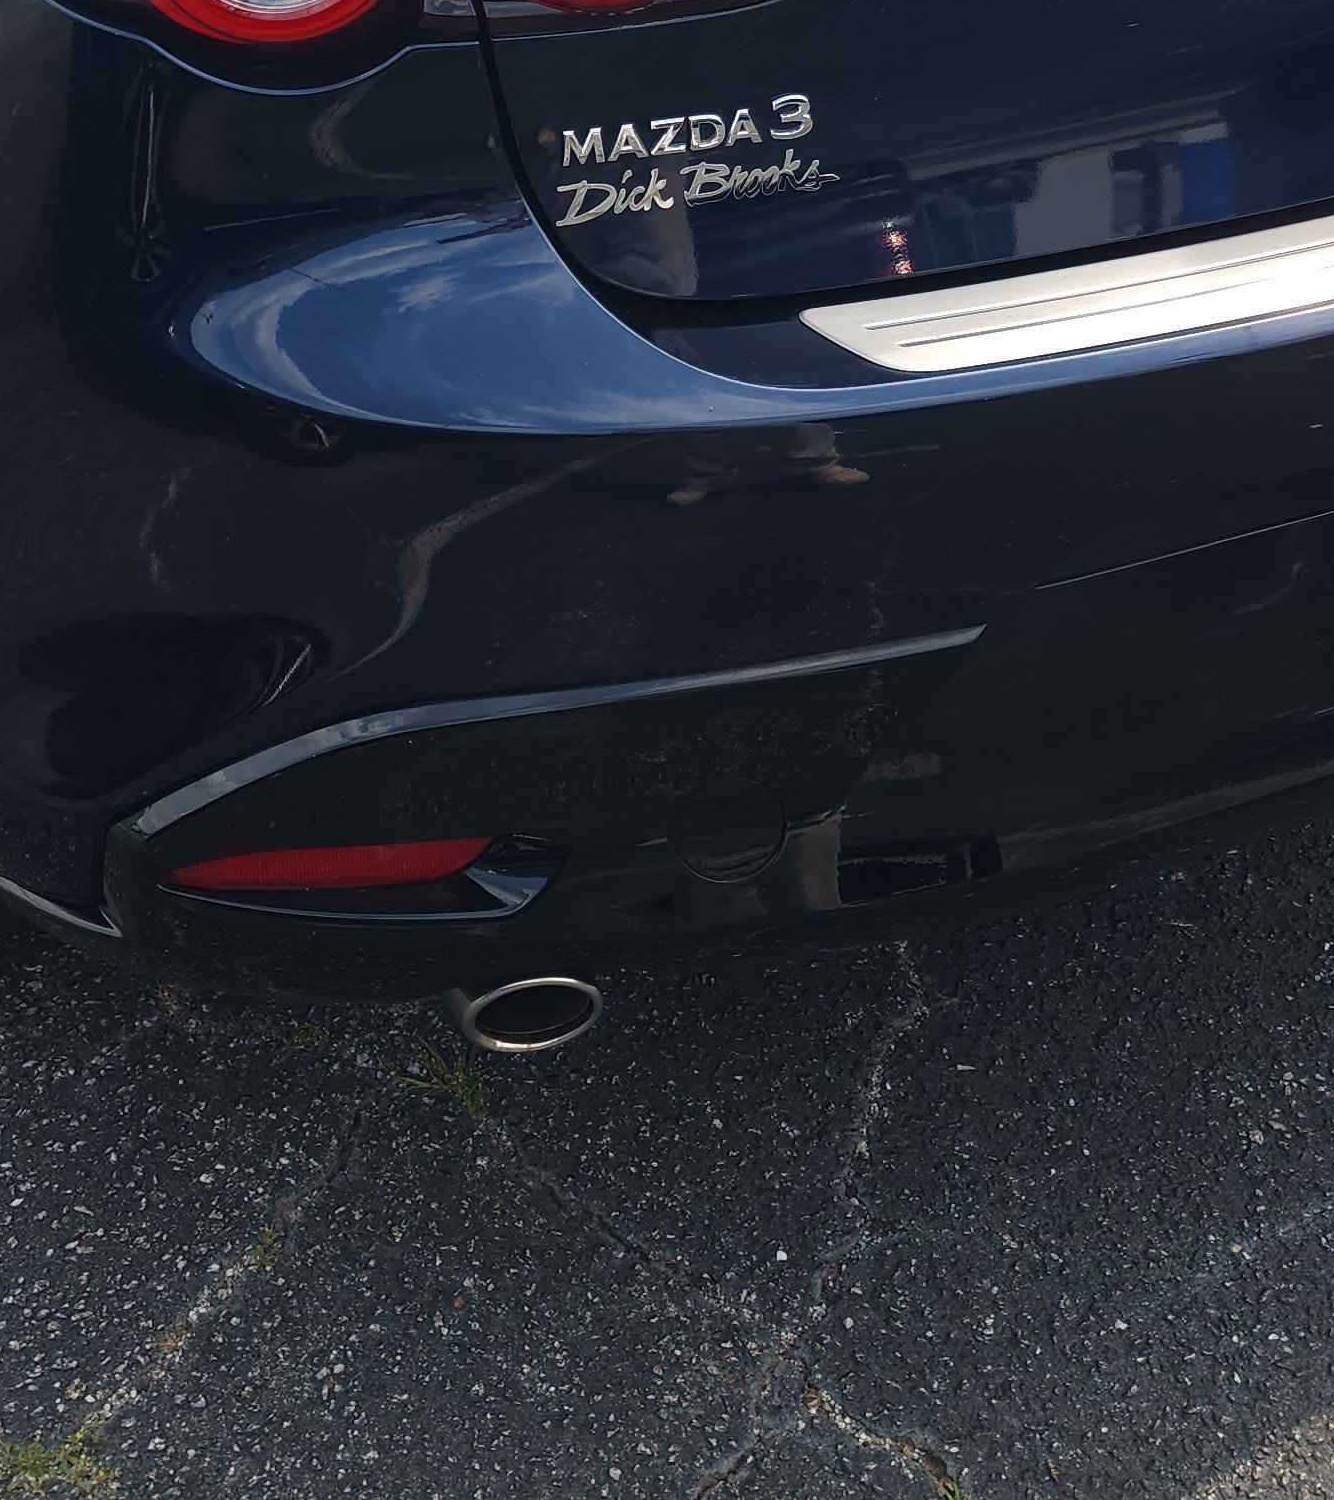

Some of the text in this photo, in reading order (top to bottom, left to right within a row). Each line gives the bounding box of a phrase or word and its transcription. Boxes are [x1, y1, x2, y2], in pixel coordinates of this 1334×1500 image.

[562, 94, 814, 167] MAZDA 3
[555, 148, 841, 227] Dick Brooks
